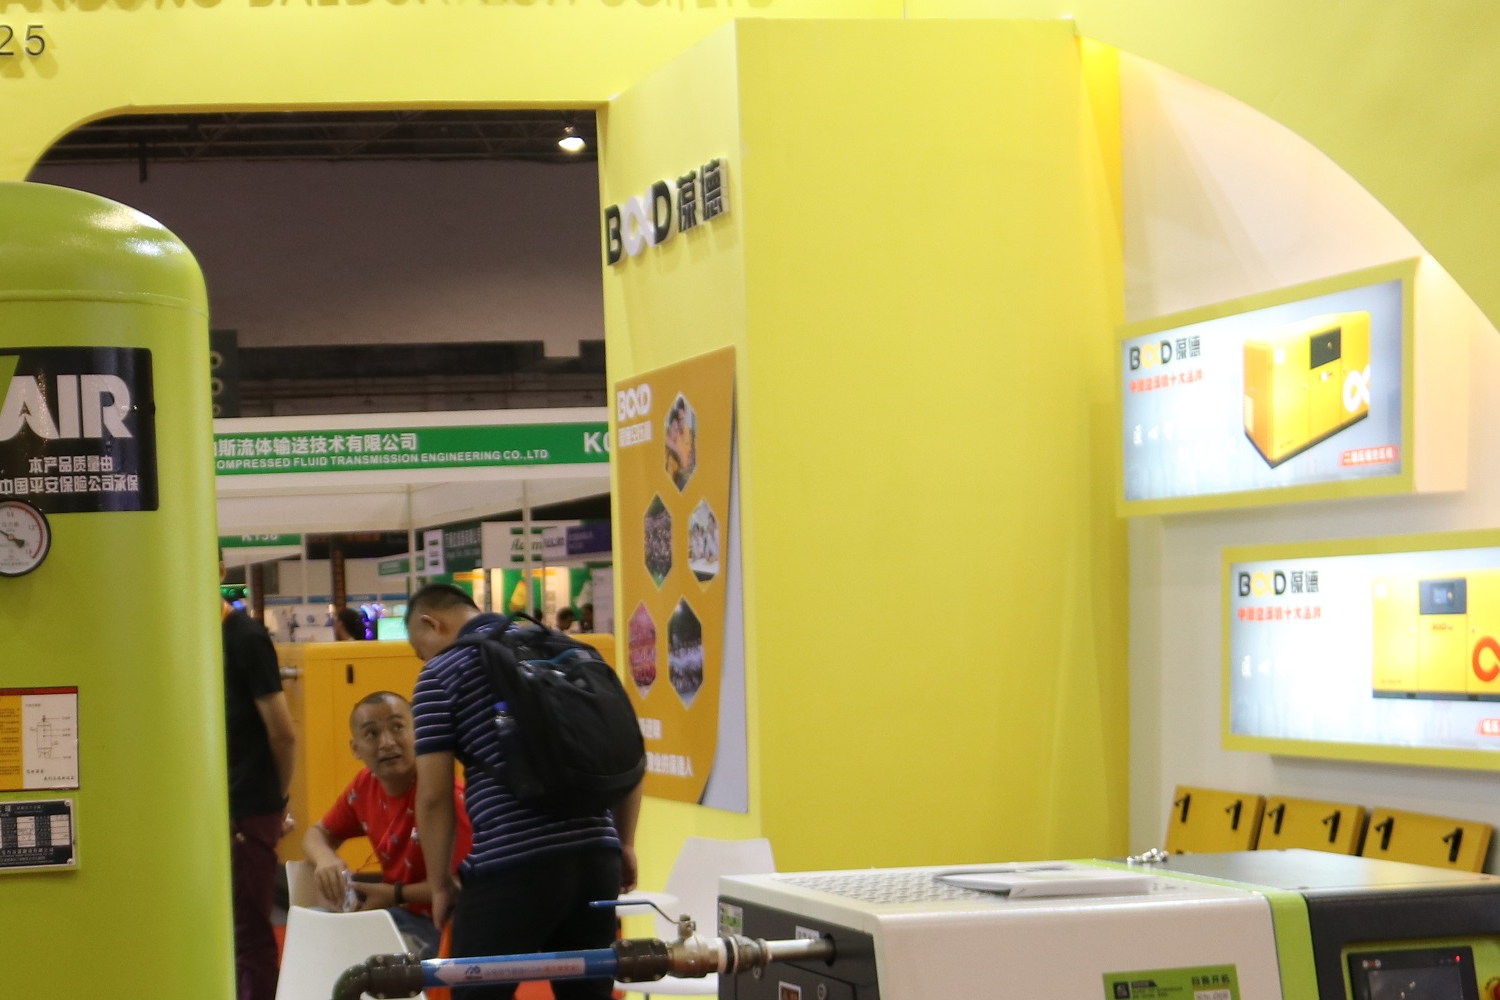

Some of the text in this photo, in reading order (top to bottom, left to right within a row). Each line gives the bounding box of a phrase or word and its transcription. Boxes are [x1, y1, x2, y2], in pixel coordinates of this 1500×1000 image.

[213, 432, 417, 457] 斯流体输送技术有限公司
[28, 455, 113, 474] 本产品质量由
[215, 456, 292, 470] OMPRESSED
[293, 455, 328, 468] FLUID
[331, 452, 418, 467] TRANSMISSION
[421, 449, 501, 462] ENGINEERING
